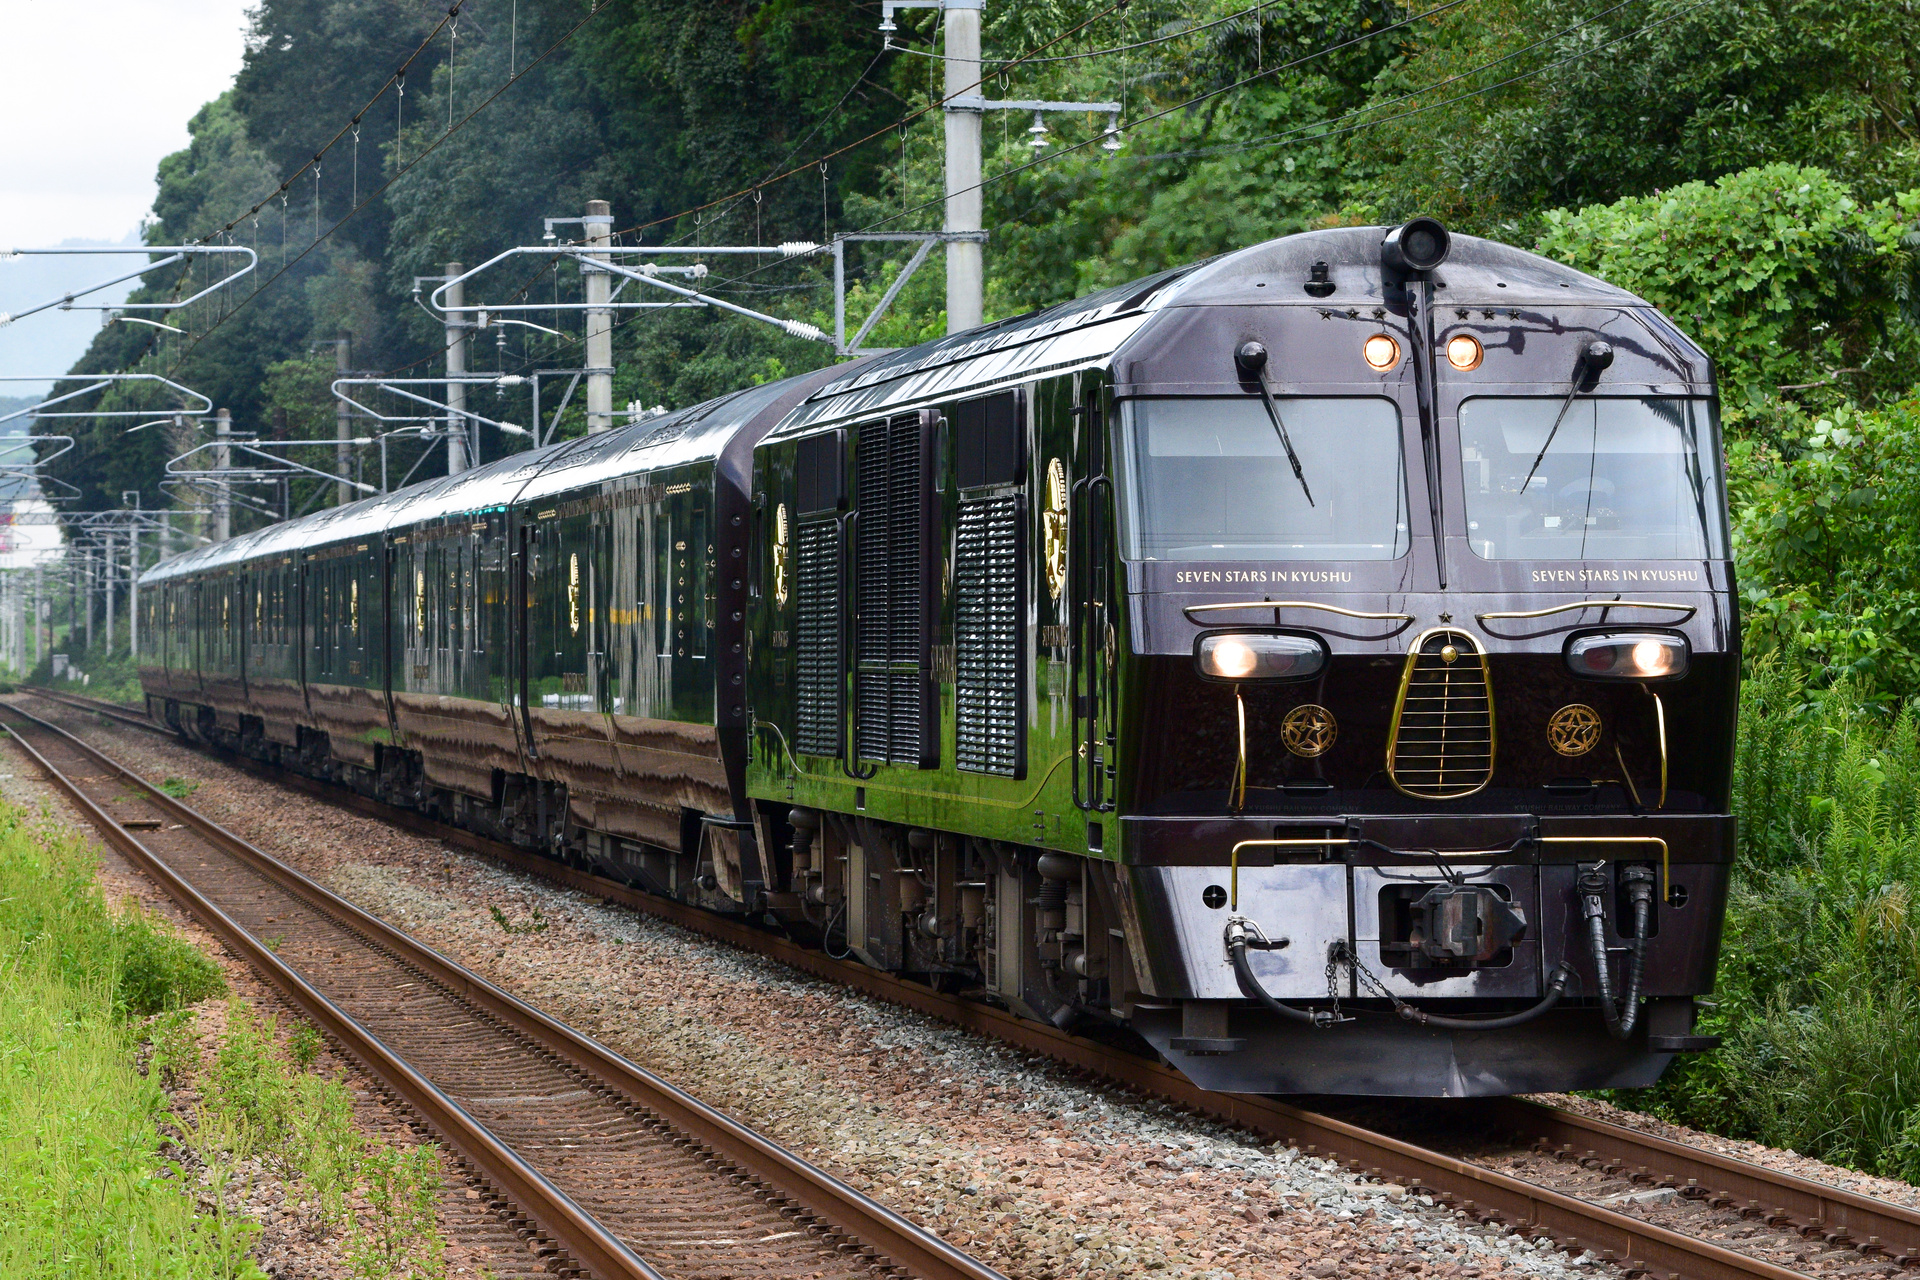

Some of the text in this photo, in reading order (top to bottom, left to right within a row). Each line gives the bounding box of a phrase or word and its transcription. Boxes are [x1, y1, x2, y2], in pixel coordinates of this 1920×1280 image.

[1176, 570, 1352, 583] SEVEN STARS IN KYUSHU
[1532, 569, 1698, 582] SEVEN STARS IN KYUSHU
[1248, 804, 1359, 812] KYUSHU RAILWAY COMPANY
[1514, 804, 1546, 812] KYUSHU
[1583, 803, 1621, 811] COMPANY
